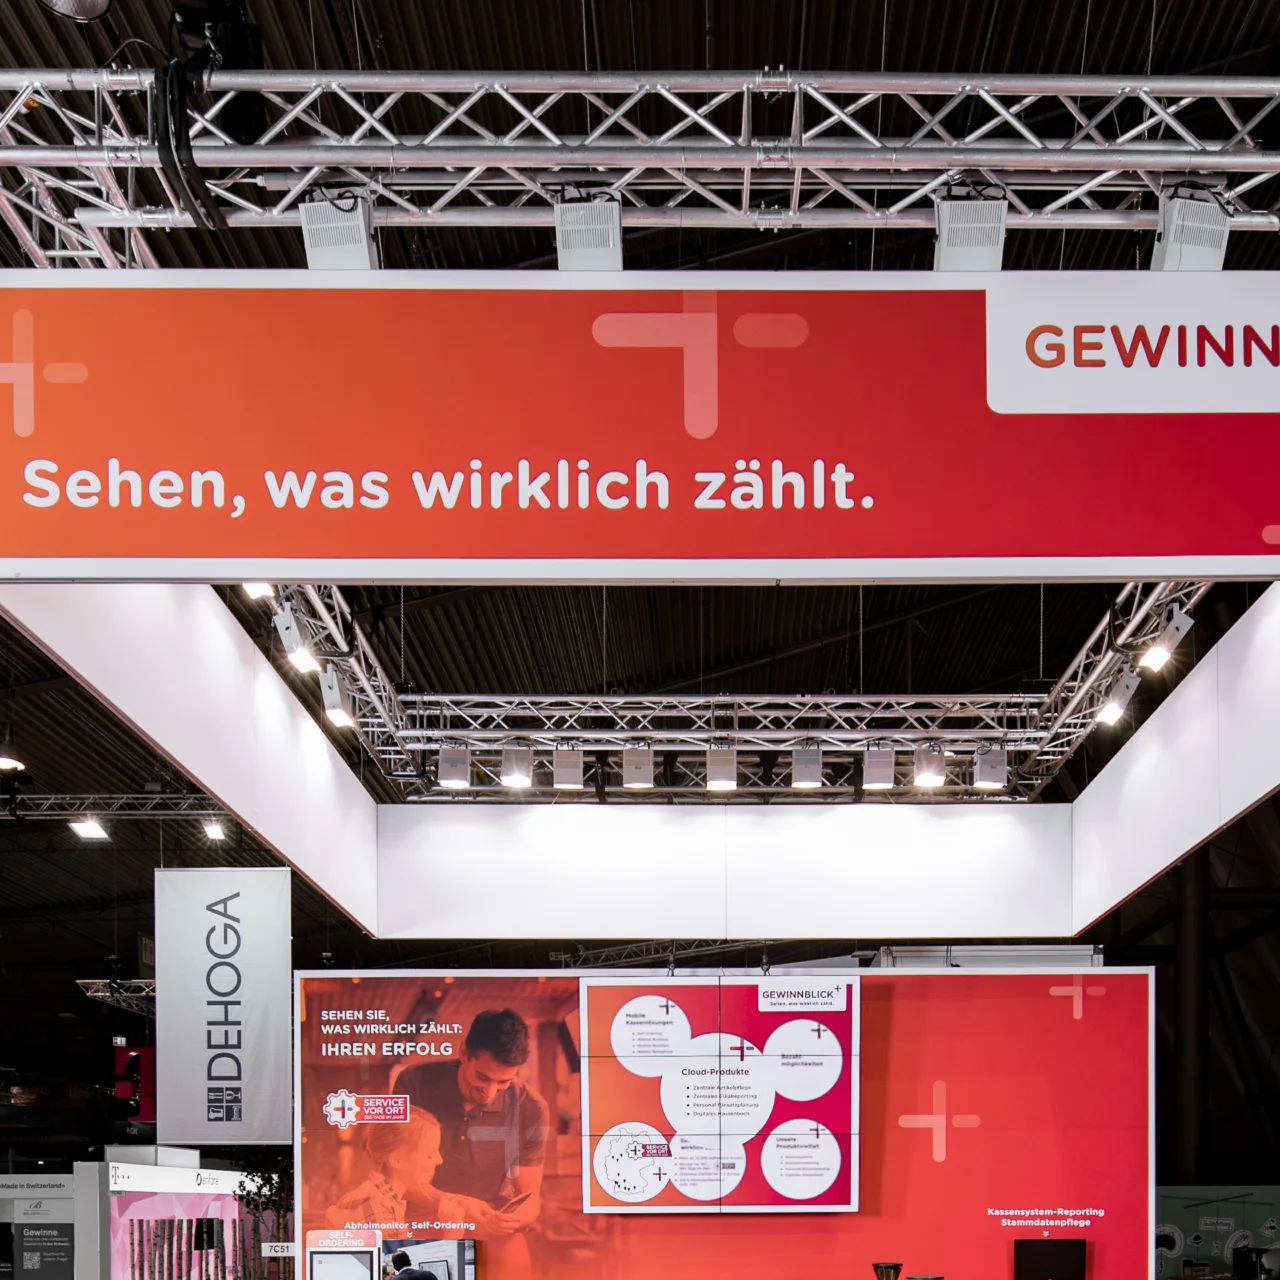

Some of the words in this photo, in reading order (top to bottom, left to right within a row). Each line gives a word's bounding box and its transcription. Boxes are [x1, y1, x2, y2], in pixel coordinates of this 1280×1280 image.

[22, 459, 245, 516] Sehen,
[265, 467, 390, 509] was
[413, 457, 670, 509] wirklich
[693, 456, 874, 509] zählt.
[206, 891, 241, 1081] DEHOGA
[762, 990, 834, 1000] GEWINNBLICK
[321, 1010, 363, 1021] SEHEN
[366, 1010, 390, 1022] SIE,
[321, 1024, 350, 1035] WAS
[354, 1023, 416, 1035] WIRKLICH
[419, 1021, 463, 1034] ZÄHLT:
[321, 1042, 376, 1056] IHREN
[381, 1042, 453, 1056] ERFOLG
[681, 1068, 750, 1076] Cloud-Produkte
[363, 1099, 405, 1108] SERVICE
[363, 1107, 383, 1115] VOR
[385, 1107, 405, 1115] ORT
[987, 1207, 1105, 1218] Kassensystem-Reporting
[344, 1221, 409, 1230] Abholmonitor
[411, 1221, 476, 1231] Self-Ordering
[1001, 1217, 1092, 1229] Stammdatenpflege
[23, 1228, 59, 1237] Gewinne
[329, 1231, 354, 1239] SELF-
[318, 1239, 365, 1247] ORDERING
[268, 1245, 290, 1254] 7C51
